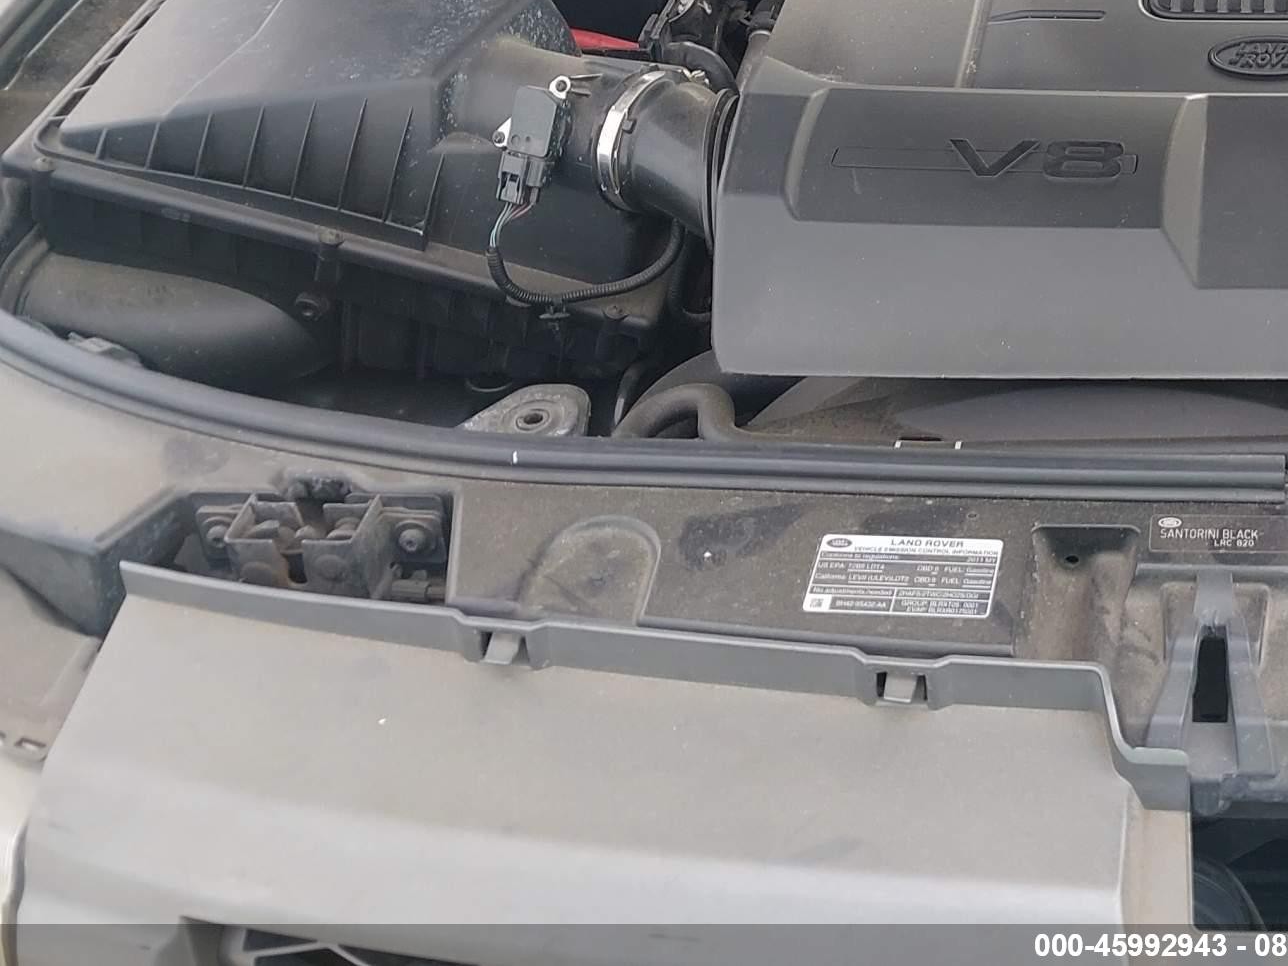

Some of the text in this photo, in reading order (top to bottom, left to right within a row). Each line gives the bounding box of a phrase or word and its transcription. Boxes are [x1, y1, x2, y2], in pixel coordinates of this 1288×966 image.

[949, 137, 1125, 180] V8
[1159, 528, 1258, 540] SANTORINI BLACK
[891, 538, 964, 548] LAND ROVER
